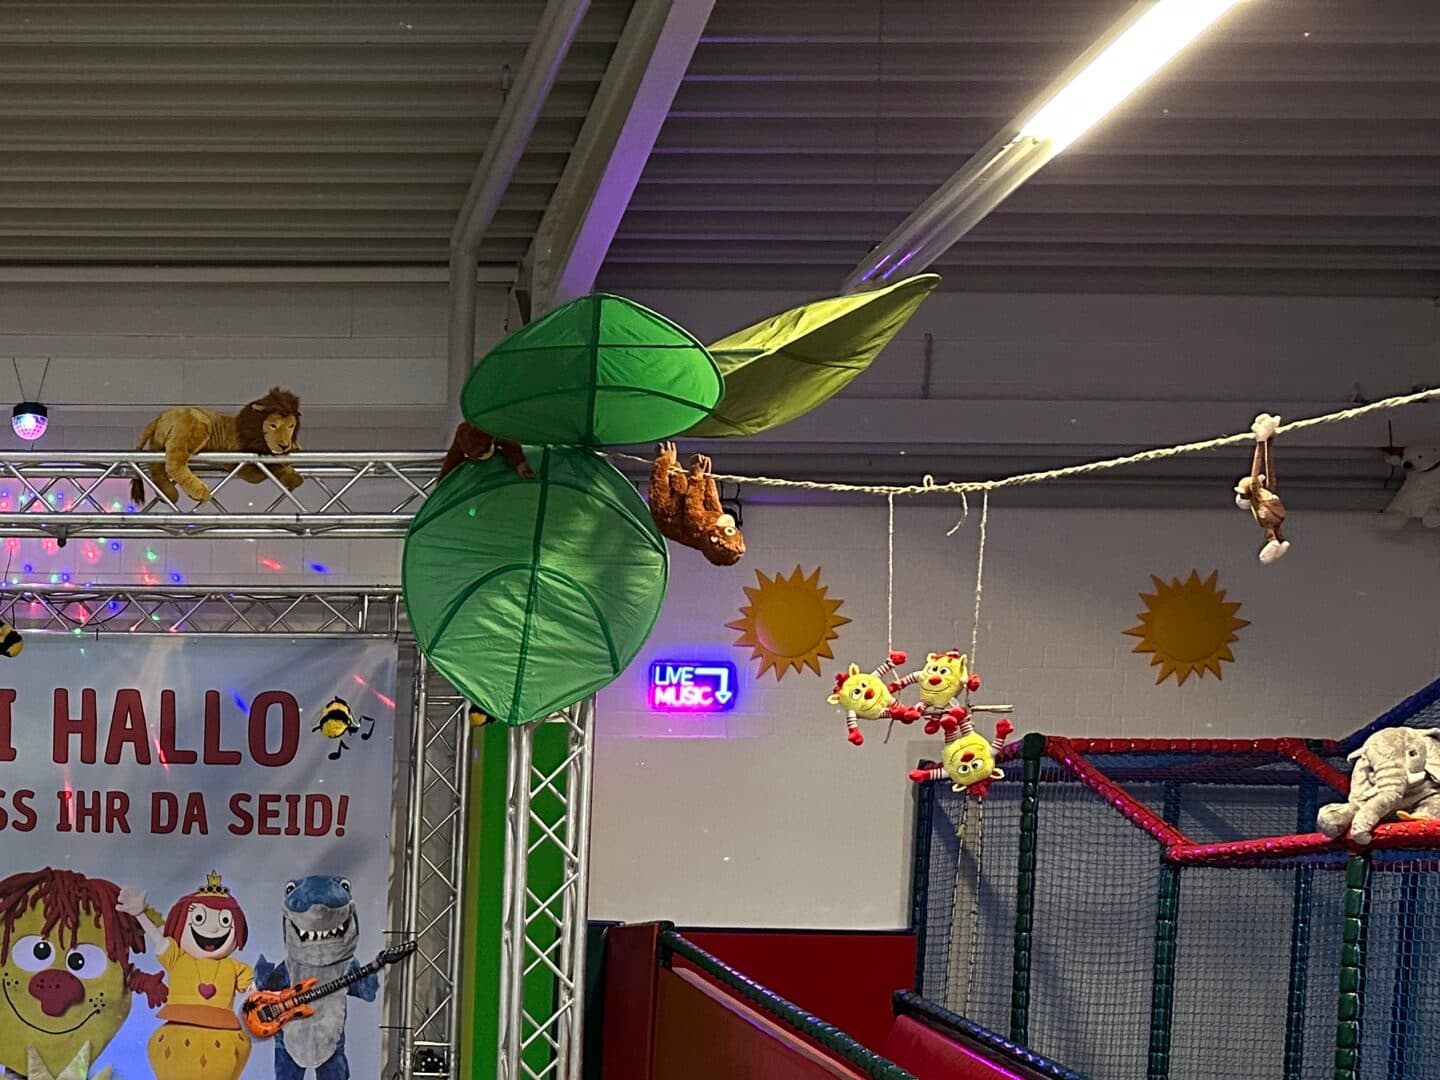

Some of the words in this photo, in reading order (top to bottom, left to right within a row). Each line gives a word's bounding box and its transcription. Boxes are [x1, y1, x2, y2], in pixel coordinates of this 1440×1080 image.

[655, 666, 696, 686] LIVE
[655, 686, 714, 706] MUSIC
[53, 688, 301, 767] HALLO
[57, 791, 130, 833] IHR
[150, 792, 208, 835] DA
[228, 794, 350, 837] SEID!
